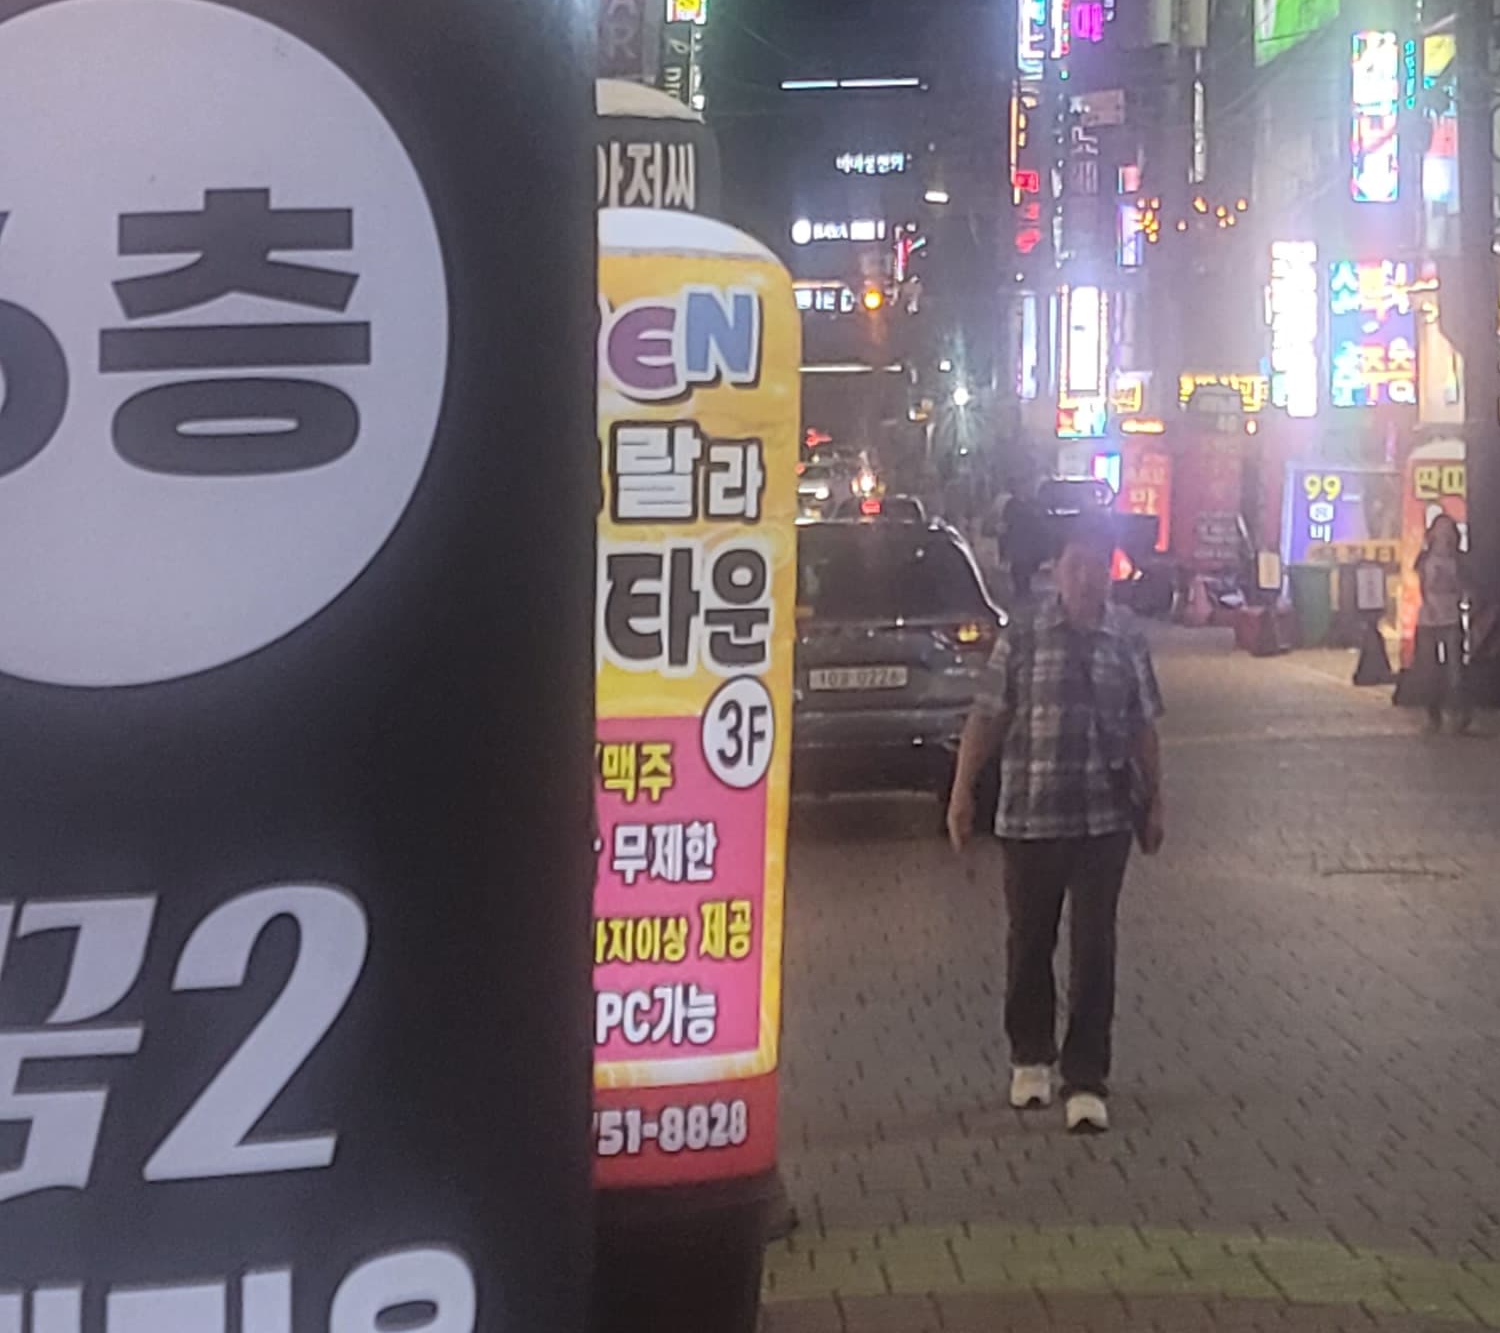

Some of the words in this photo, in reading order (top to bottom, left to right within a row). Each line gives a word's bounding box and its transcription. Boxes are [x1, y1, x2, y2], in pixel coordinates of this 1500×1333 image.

[1304, 474, 1342, 501] 99
[605, 545, 772, 668] 타운
[717, 699, 768, 770] 3F
[613, 820, 718, 885] 무제한
[700, 898, 752, 960] 제공
[595, 983, 718, 1046] PC가능
[594, 1099, 748, 1157] 51-8828
